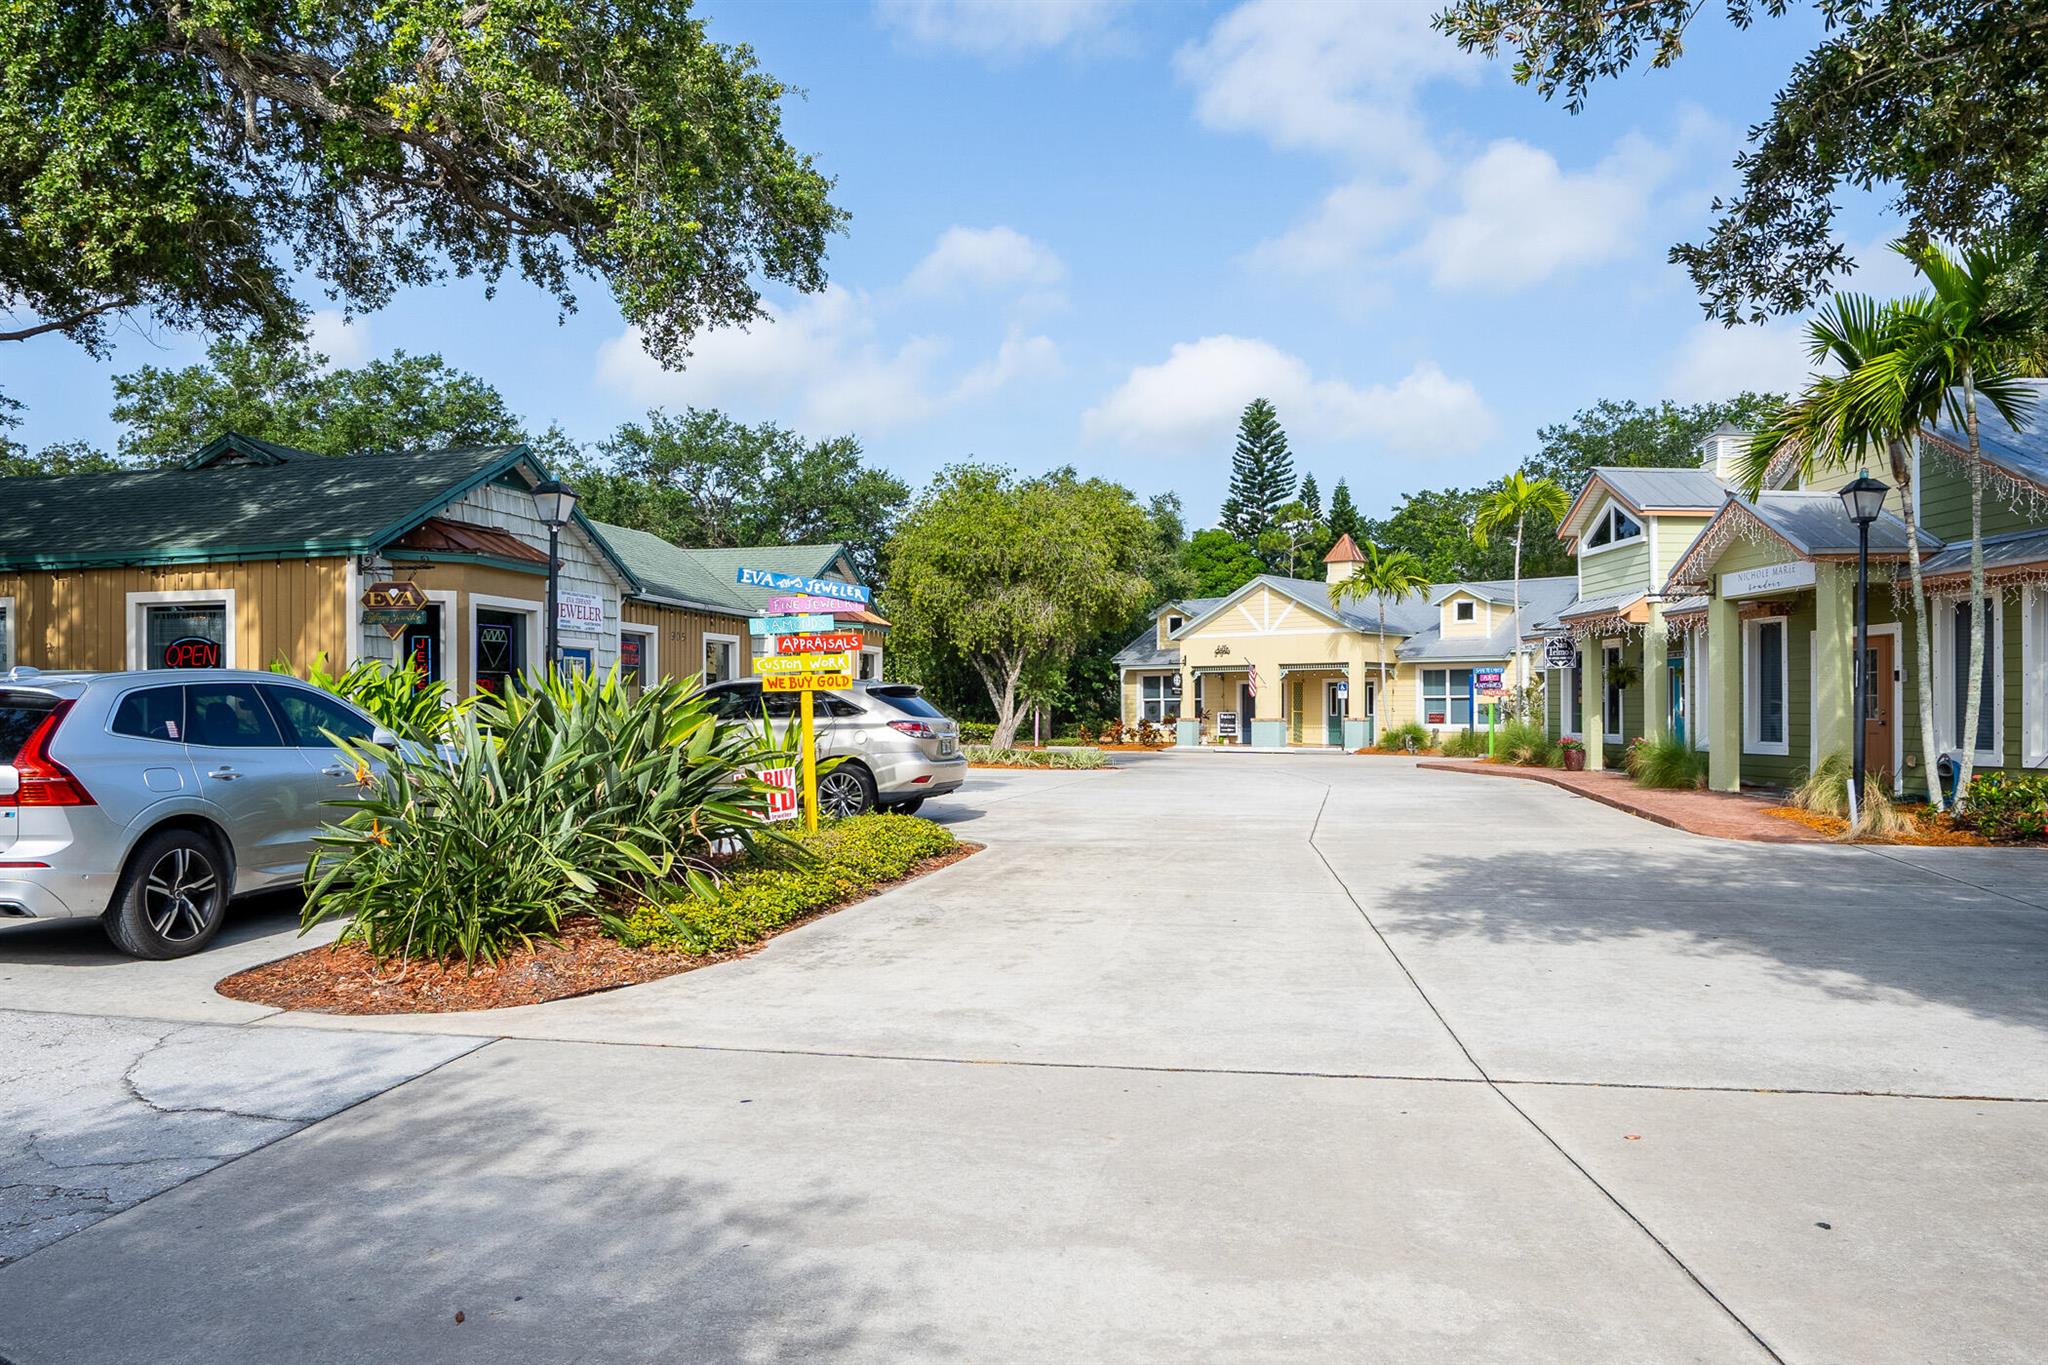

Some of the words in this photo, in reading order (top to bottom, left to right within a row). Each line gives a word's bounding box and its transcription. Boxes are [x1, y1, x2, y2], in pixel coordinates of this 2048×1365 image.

[1737, 568, 1769, 582] NICHOLE
[1772, 564, 1796, 575] MARIE
[741, 568, 775, 587] EVA
[805, 579, 865, 600] JEWELER
[368, 592, 418, 606] EVA
[773, 600, 799, 610] FINE
[165, 645, 217, 667] OPEN
[757, 658, 802, 672] CUSTOM
[809, 656, 848, 669] WORK
[767, 677, 786, 689] WE
[789, 676, 812, 689] BUY
[817, 675, 849, 687] GOLD
[763, 769, 793, 787] BUY
